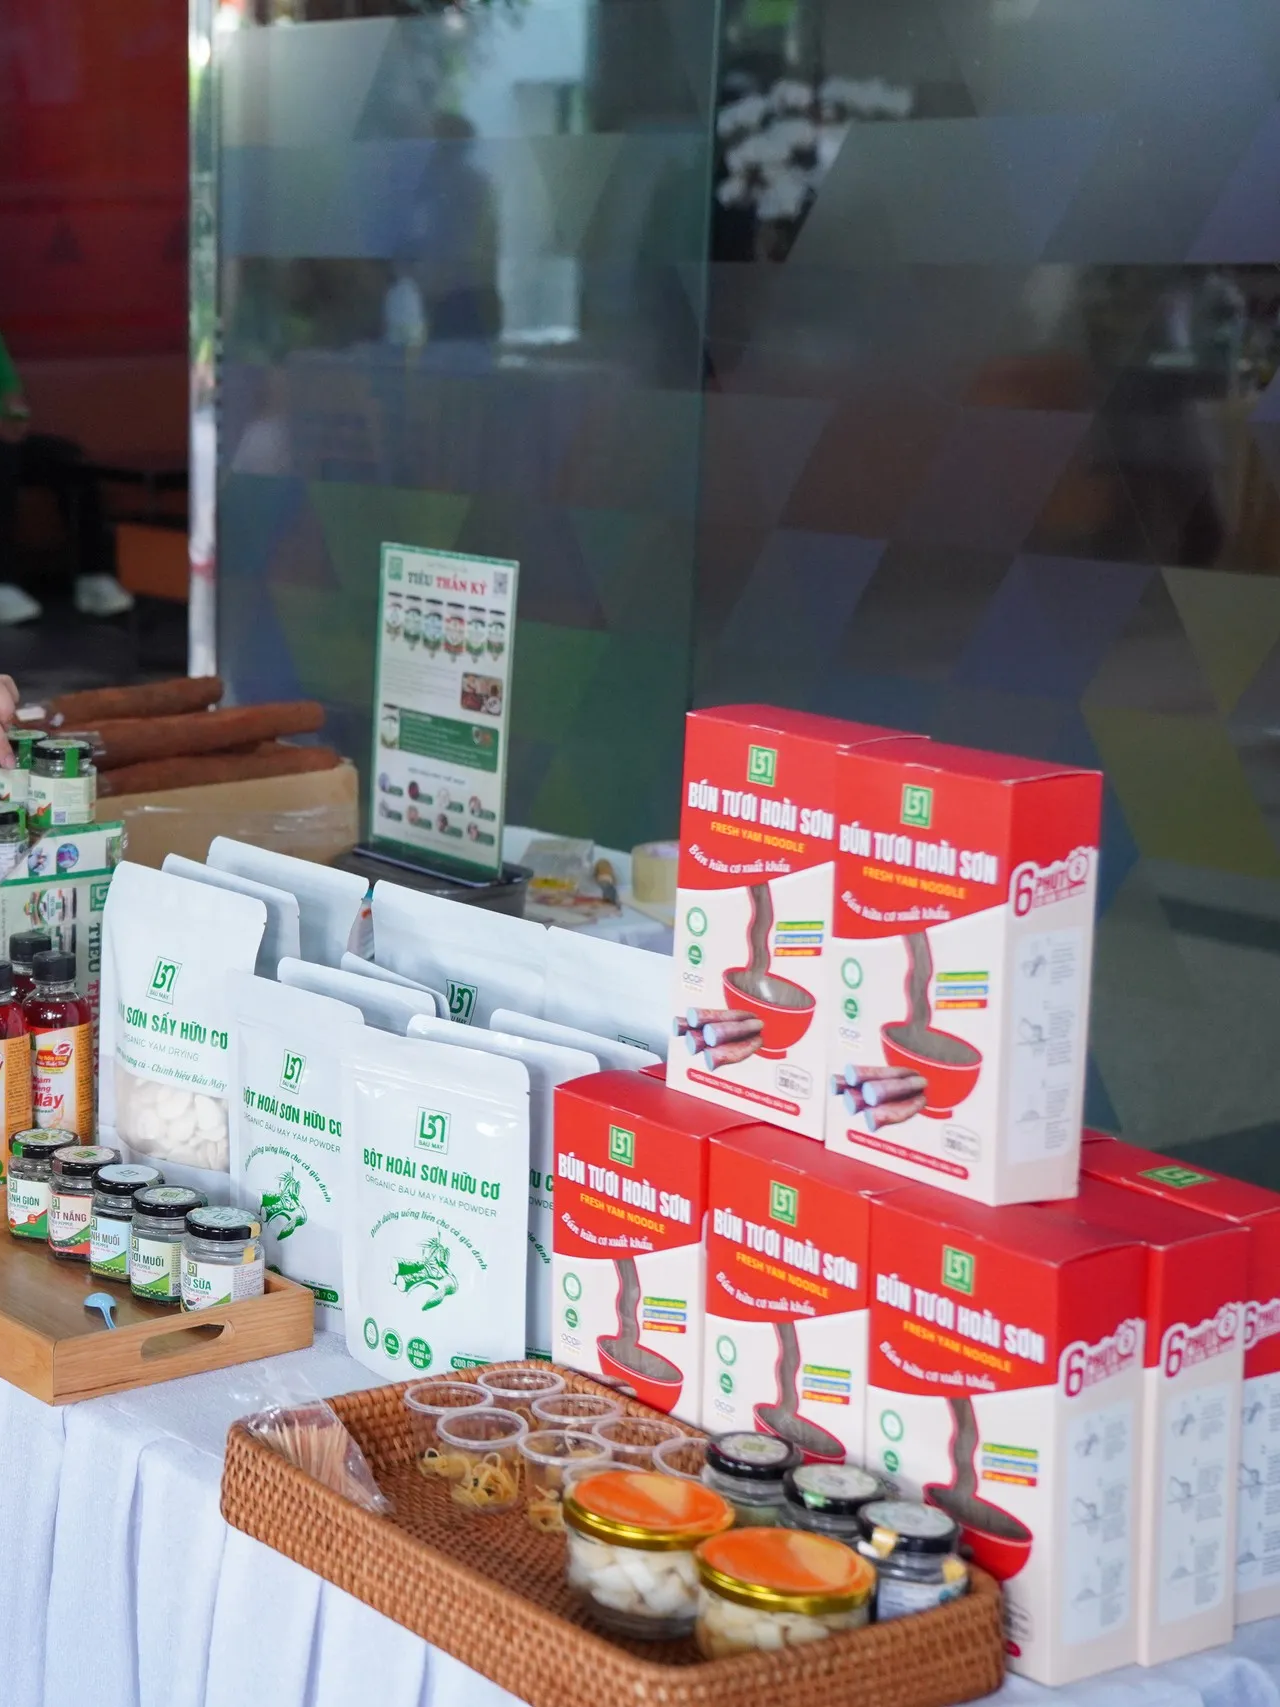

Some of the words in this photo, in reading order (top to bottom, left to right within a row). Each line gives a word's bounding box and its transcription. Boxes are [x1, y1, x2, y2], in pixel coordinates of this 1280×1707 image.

[688, 779, 718, 812] BÚN
[722, 789, 757, 821] TƯƠI
[760, 797, 797, 831] HOÀI
[800, 808, 834, 840] SƠN
[689, 844, 708, 866] Bún
[710, 821, 739, 837] FRESH
[741, 828, 762, 843] YAM
[763, 834, 805, 853] NOODLE
[839, 821, 871, 857] BÚN
[874, 832, 912, 866] TƯƠI
[915, 839, 956, 876] HOÀI
[959, 850, 998, 885] SƠN
[862, 866, 893, 883] FRESH
[895, 873, 919, 888] YAM
[920, 879, 967, 899] NOODLE
[1014, 868, 1034, 917] 6
[126, 1006, 148, 1029] SƠN
[151, 1011, 177, 1037] SẤY
[180, 1021, 207, 1044] HỮU
[210, 1029, 228, 1050] CƠ
[148, 1040, 166, 1053] YAM
[168, 1046, 200, 1062] DRYING
[34, 1092, 64, 1109] Mây
[258, 1094, 279, 1116] HOÀI
[279, 1102, 300, 1124] SƠN
[303, 1110, 326, 1133] HỮU
[264, 1121, 276, 1133] BAU
[277, 1127, 291, 1140] MAY
[291, 1132, 308, 1144] YAM
[310, 1137, 341, 1154] POWDER
[418, 1139, 431, 1148] BAU
[431, 1141, 444, 1150] MAY
[290, 1153, 302, 1164] cho
[308, 1168, 321, 1183] gia
[363, 1148, 383, 1172] BỘT
[386, 1156, 416, 1179] HOÀI
[420, 1164, 448, 1187] SƠN
[451, 1171, 477, 1195] HỮU
[480, 1181, 501, 1201] CƠ
[558, 1151, 585, 1185] BÚN
[588, 1164, 619, 1199] TƯƠI
[622, 1178, 656, 1212] HOÀI
[659, 1191, 691, 1225] SƠN
[365, 1174, 397, 1192] ORGANIC
[398, 1185, 416, 1197] BAU
[418, 1189, 437, 1202] MAY
[438, 1196, 457, 1208] YAM
[458, 1200, 498, 1218] POWDER
[529, 1196, 554, 1210] OWDE
[580, 1193, 605, 1211] FRESH
[606, 1203, 626, 1219] YAM
[627, 1211, 665, 1235] NOODLE
[436, 1218, 450, 1230] cho
[459, 1234, 473, 1249] gia
[561, 1212, 579, 1235] Bún
[713, 1207, 743, 1244] BÚN
[745, 1220, 781, 1260] TƯƠI
[783, 1239, 820, 1276] HOÀI
[822, 1252, 858, 1290] SƠN
[193, 1277, 212, 1291] SỮA
[735, 1251, 764, 1272] FRESH
[765, 1263, 786, 1281] YAM
[787, 1272, 829, 1299] NOODLE
[876, 1272, 911, 1313] BÚN
[914, 1287, 955, 1330] TƯƠI
[957, 1308, 1001, 1349] HOÀI
[1004, 1323, 1045, 1365] SƠN
[453, 1357, 466, 1368] 200
[902, 1319, 936, 1343] FRESH
[937, 1334, 961, 1354] YAM
[962, 1344, 1012, 1374] NOODLE
[1165, 1330, 1185, 1378] 6
[1065, 1348, 1084, 1397] 6
